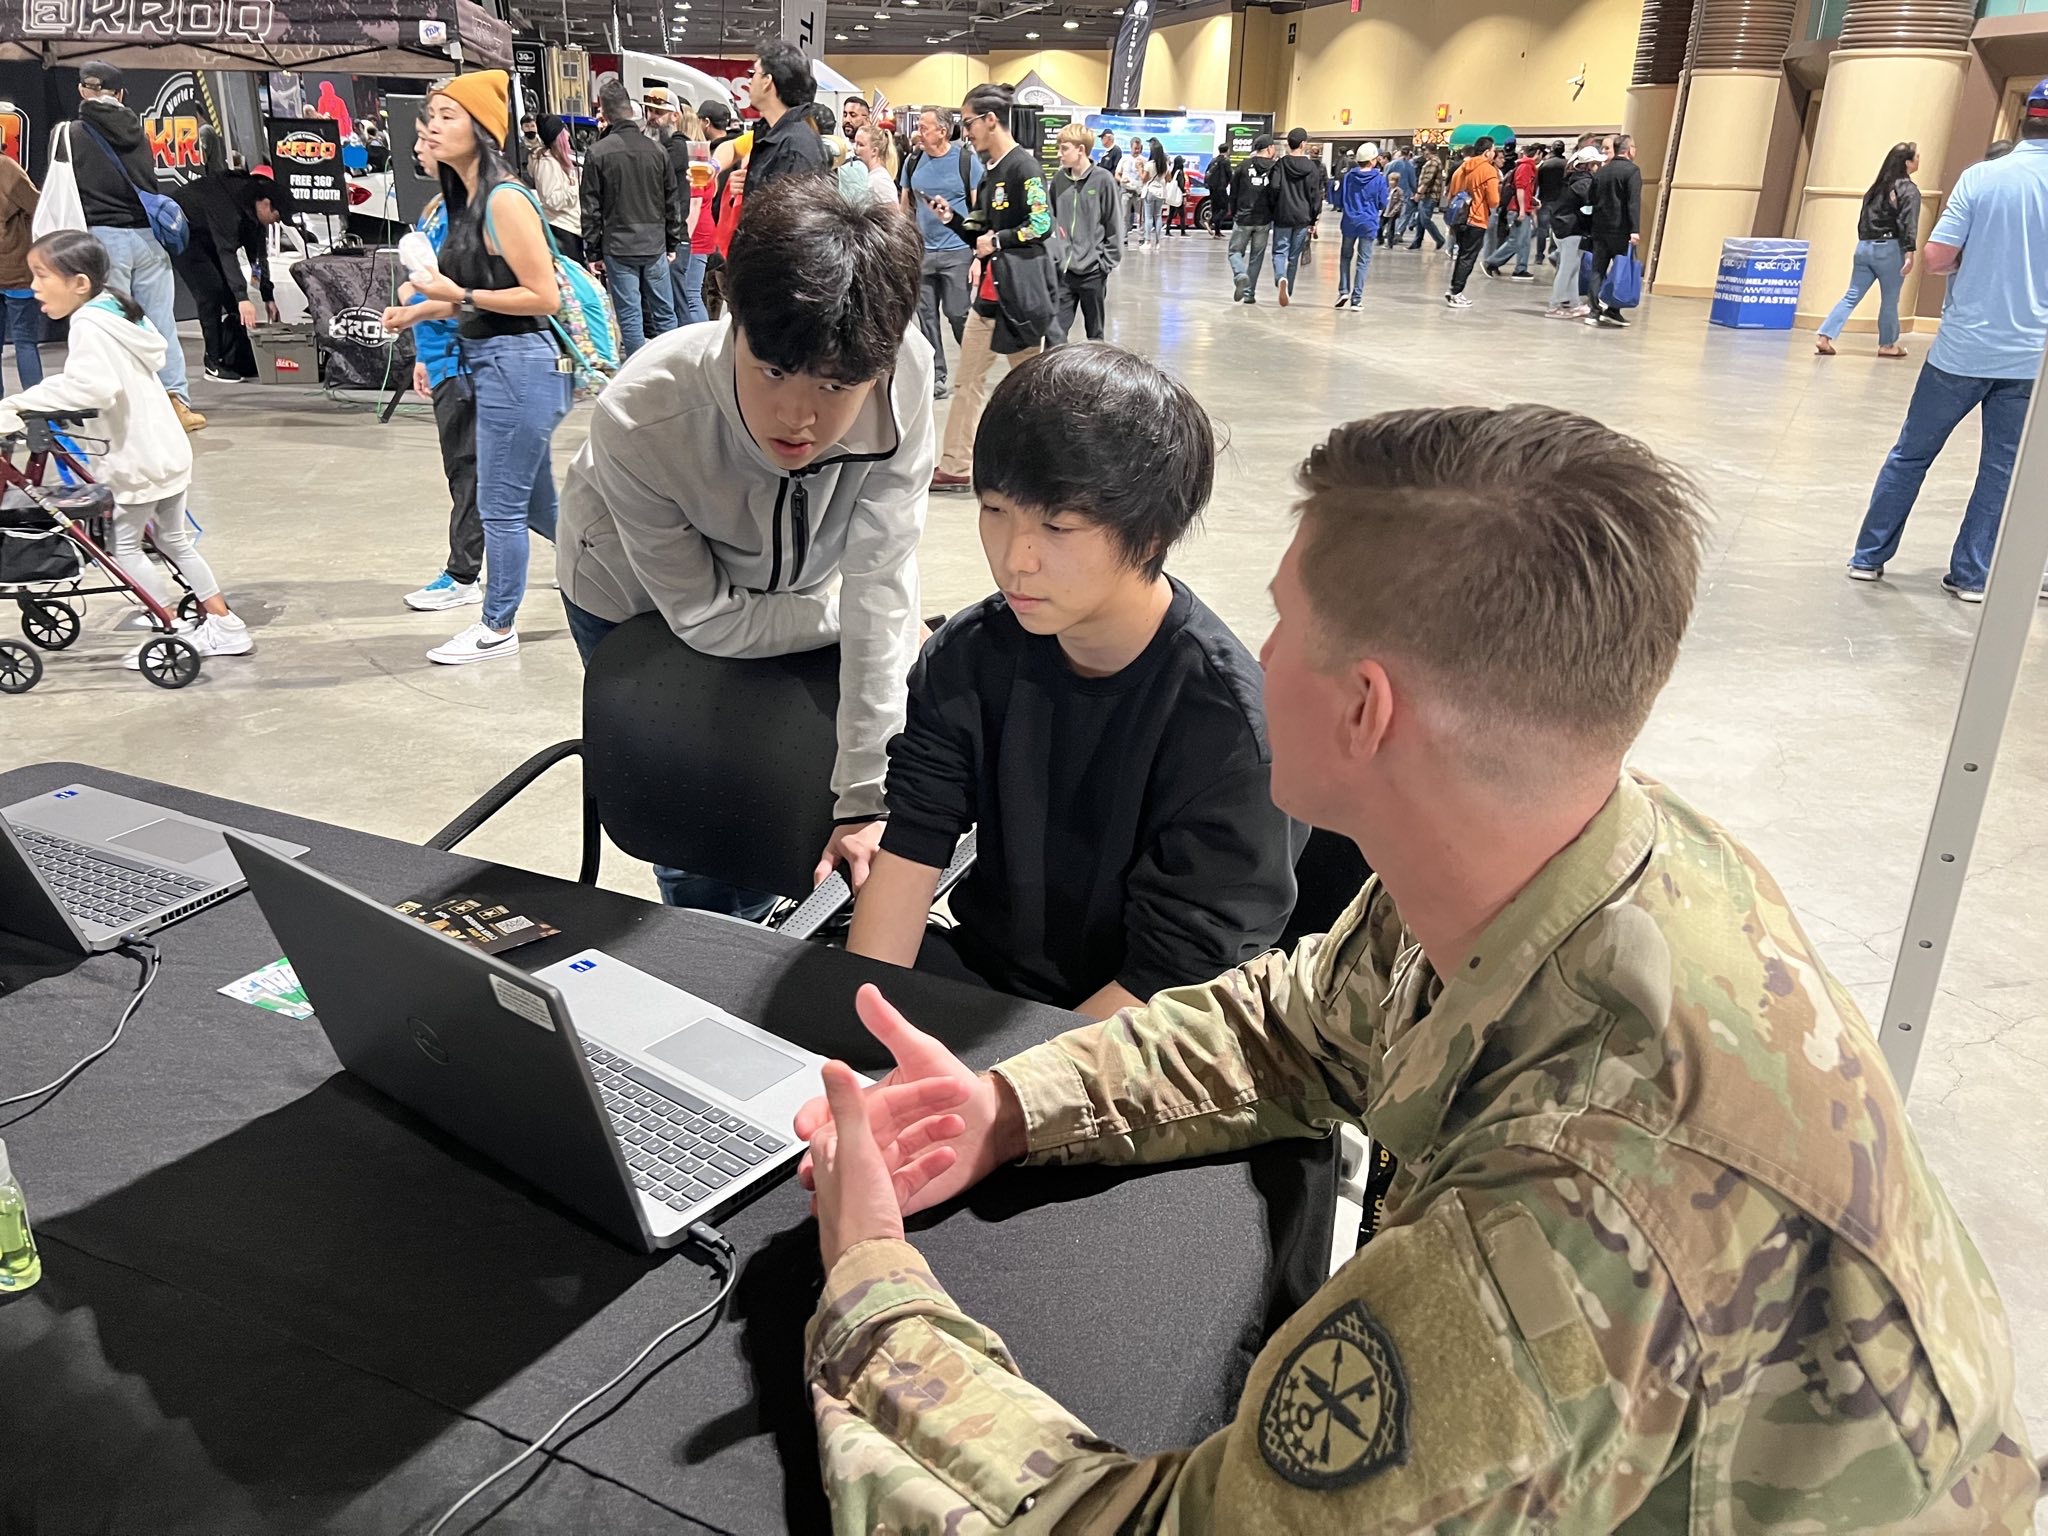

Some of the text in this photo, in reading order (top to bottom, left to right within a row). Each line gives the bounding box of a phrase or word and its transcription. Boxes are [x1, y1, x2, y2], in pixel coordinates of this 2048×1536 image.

[22, 0, 273, 44] @KROQ
[165, 88, 188, 115] World
[144, 115, 204, 168] KR
[290, 174, 312, 187] FREE
[290, 188, 341, 201] OTO BOOTH
[1745, 278, 1784, 286] HELPING
[1742, 295, 1798, 304] GO FASTER
